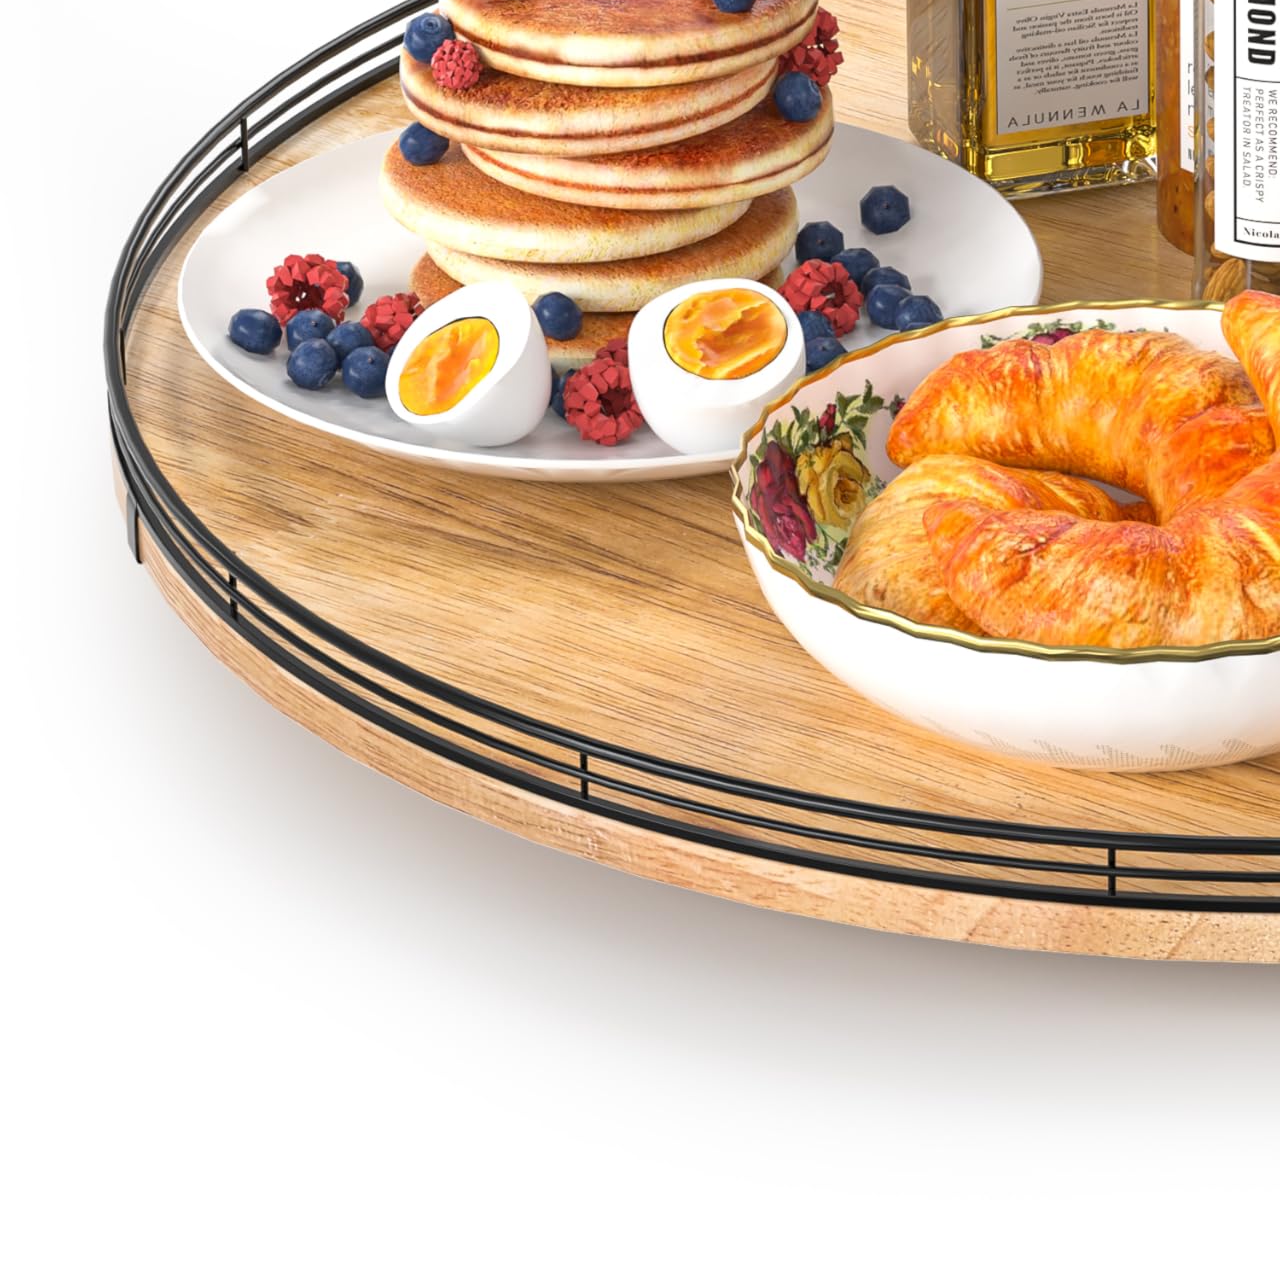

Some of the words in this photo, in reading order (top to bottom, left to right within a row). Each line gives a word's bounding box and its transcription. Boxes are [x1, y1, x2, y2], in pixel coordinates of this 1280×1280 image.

[1268, 89, 1278, 105] WE
[1255, 88, 1264, 136] PERFECT
[1242, 138, 1252, 148] IN
[1255, 138, 1264, 152] AS
[1255, 165, 1264, 203] CRISPY
